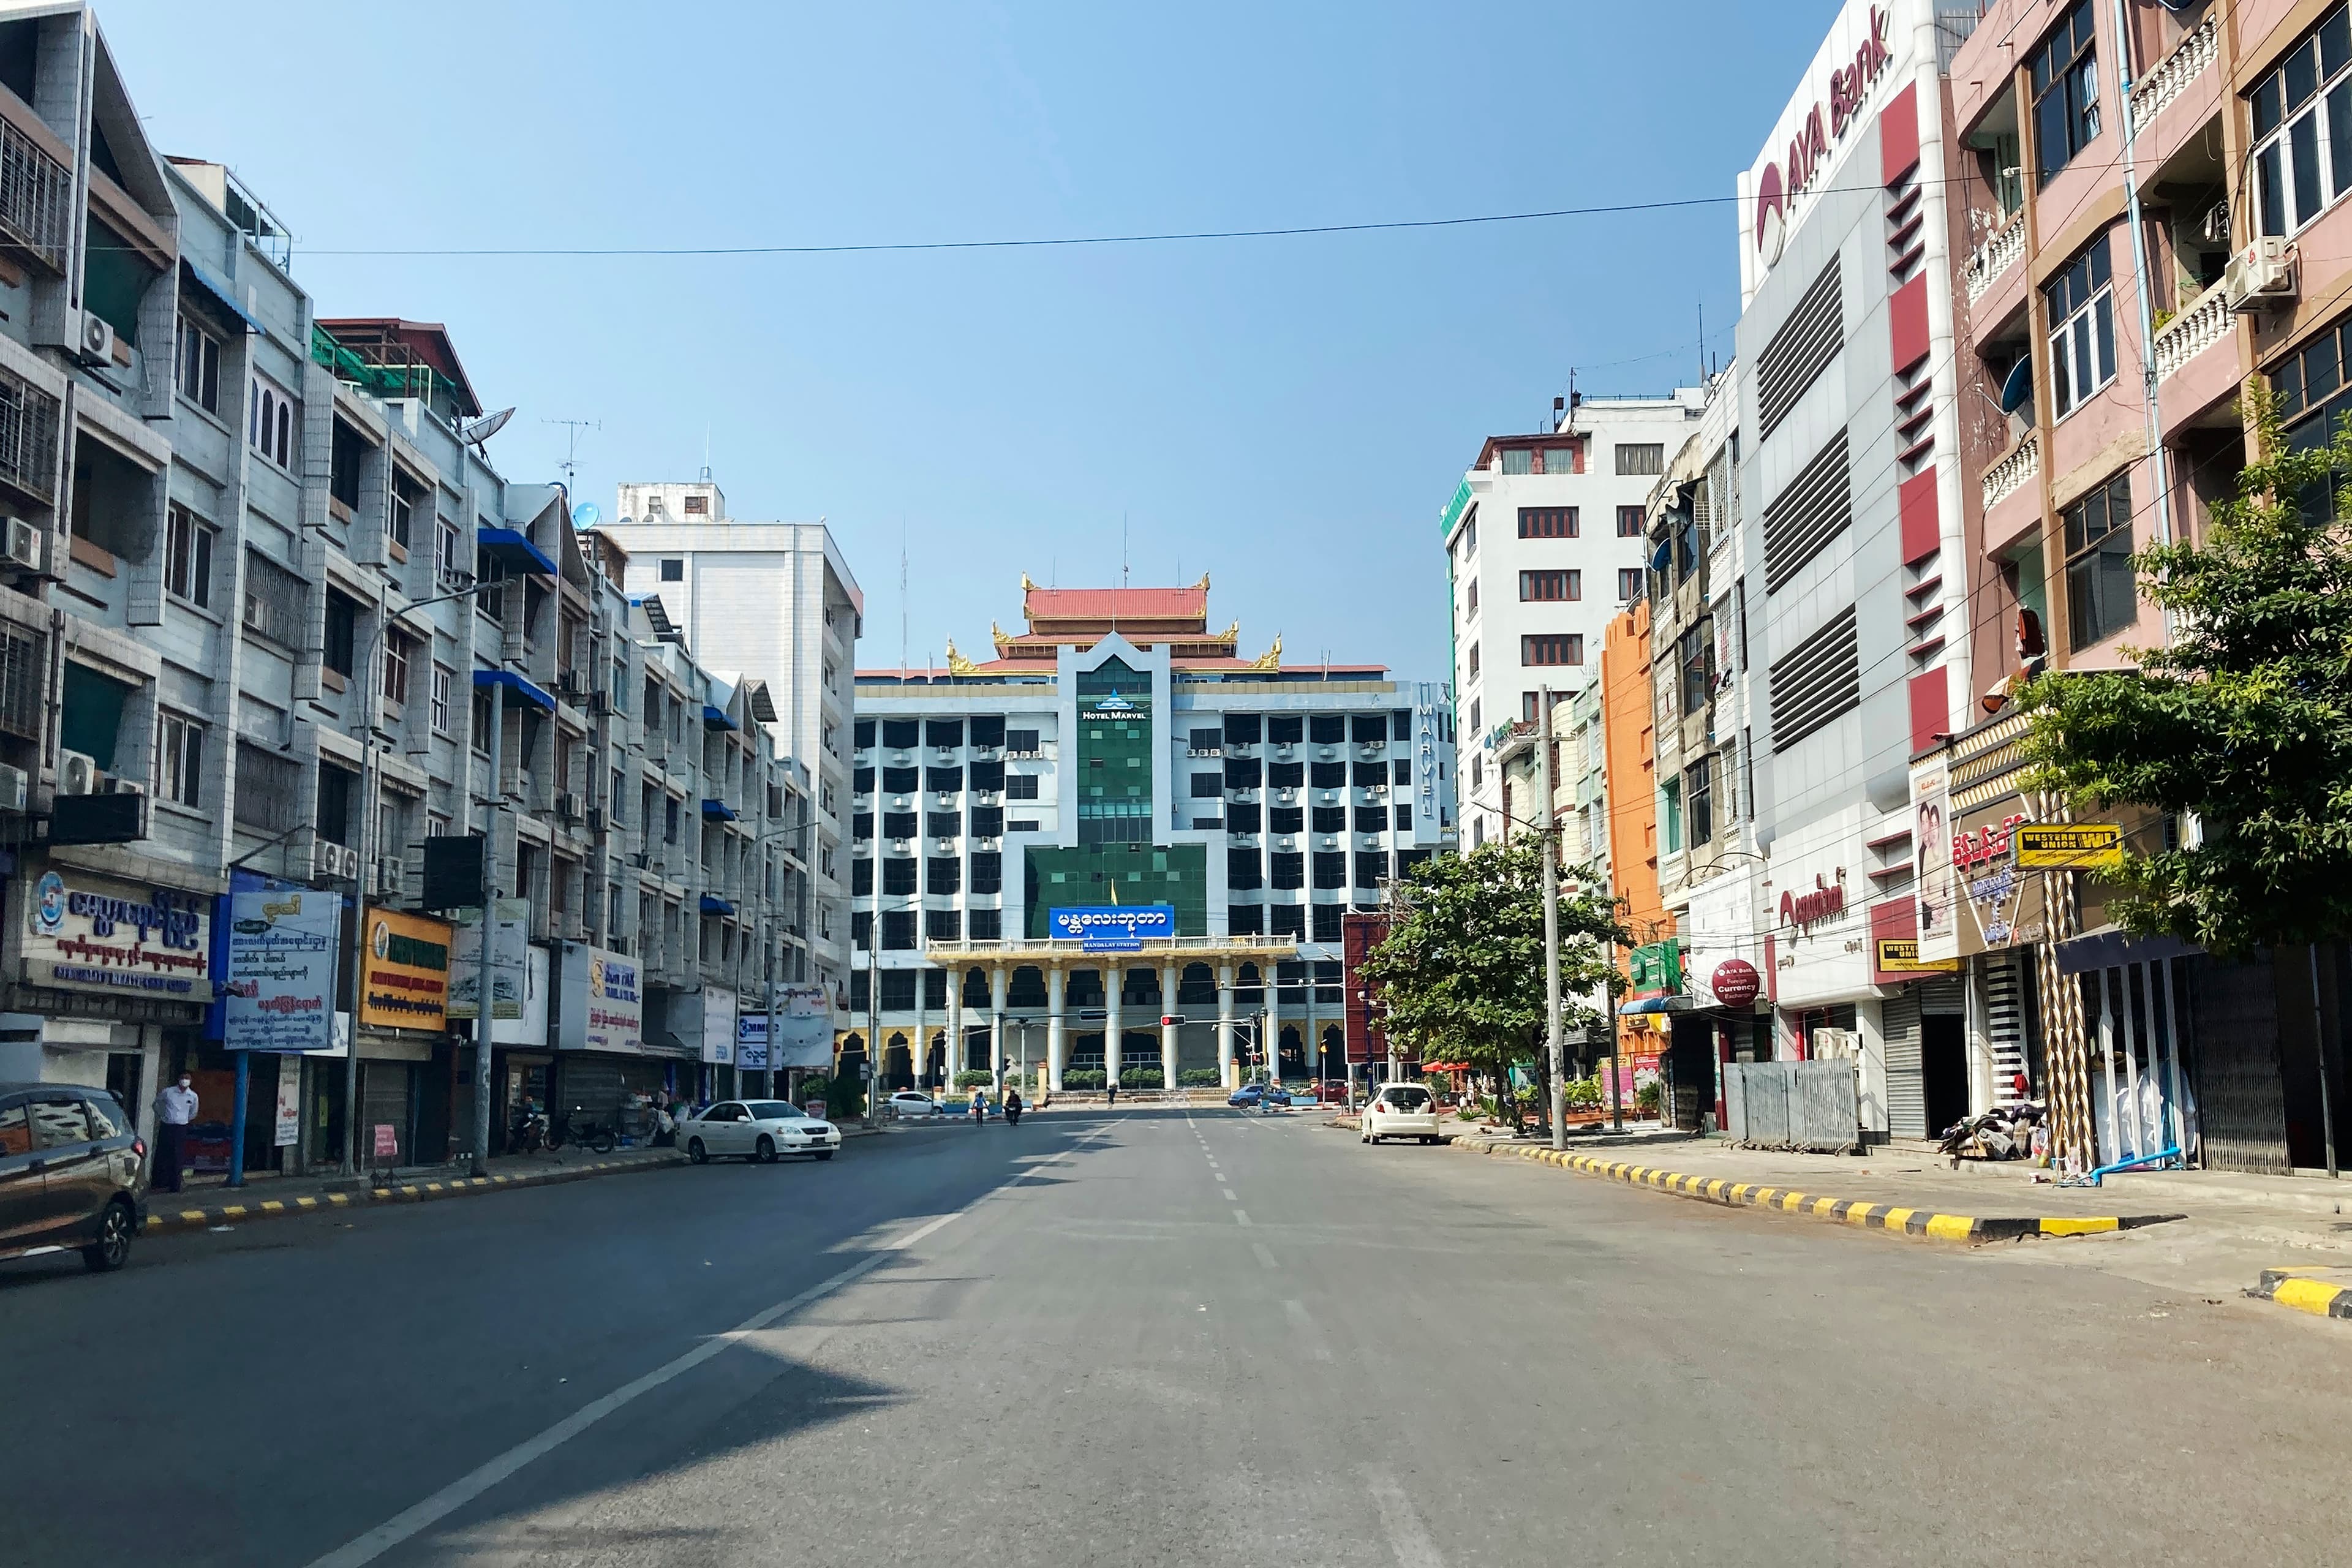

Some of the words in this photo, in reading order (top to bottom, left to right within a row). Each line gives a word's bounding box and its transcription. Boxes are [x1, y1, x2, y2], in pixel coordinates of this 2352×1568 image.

[1787, 101, 1830, 209] AYA
[1831, 4, 1890, 138] Bank
[1417, 704, 1433, 816] MARVEL
[1058, 913, 1166, 934] မန္တလေးဘူတာ
[1717, 984, 1756, 993] Currency
